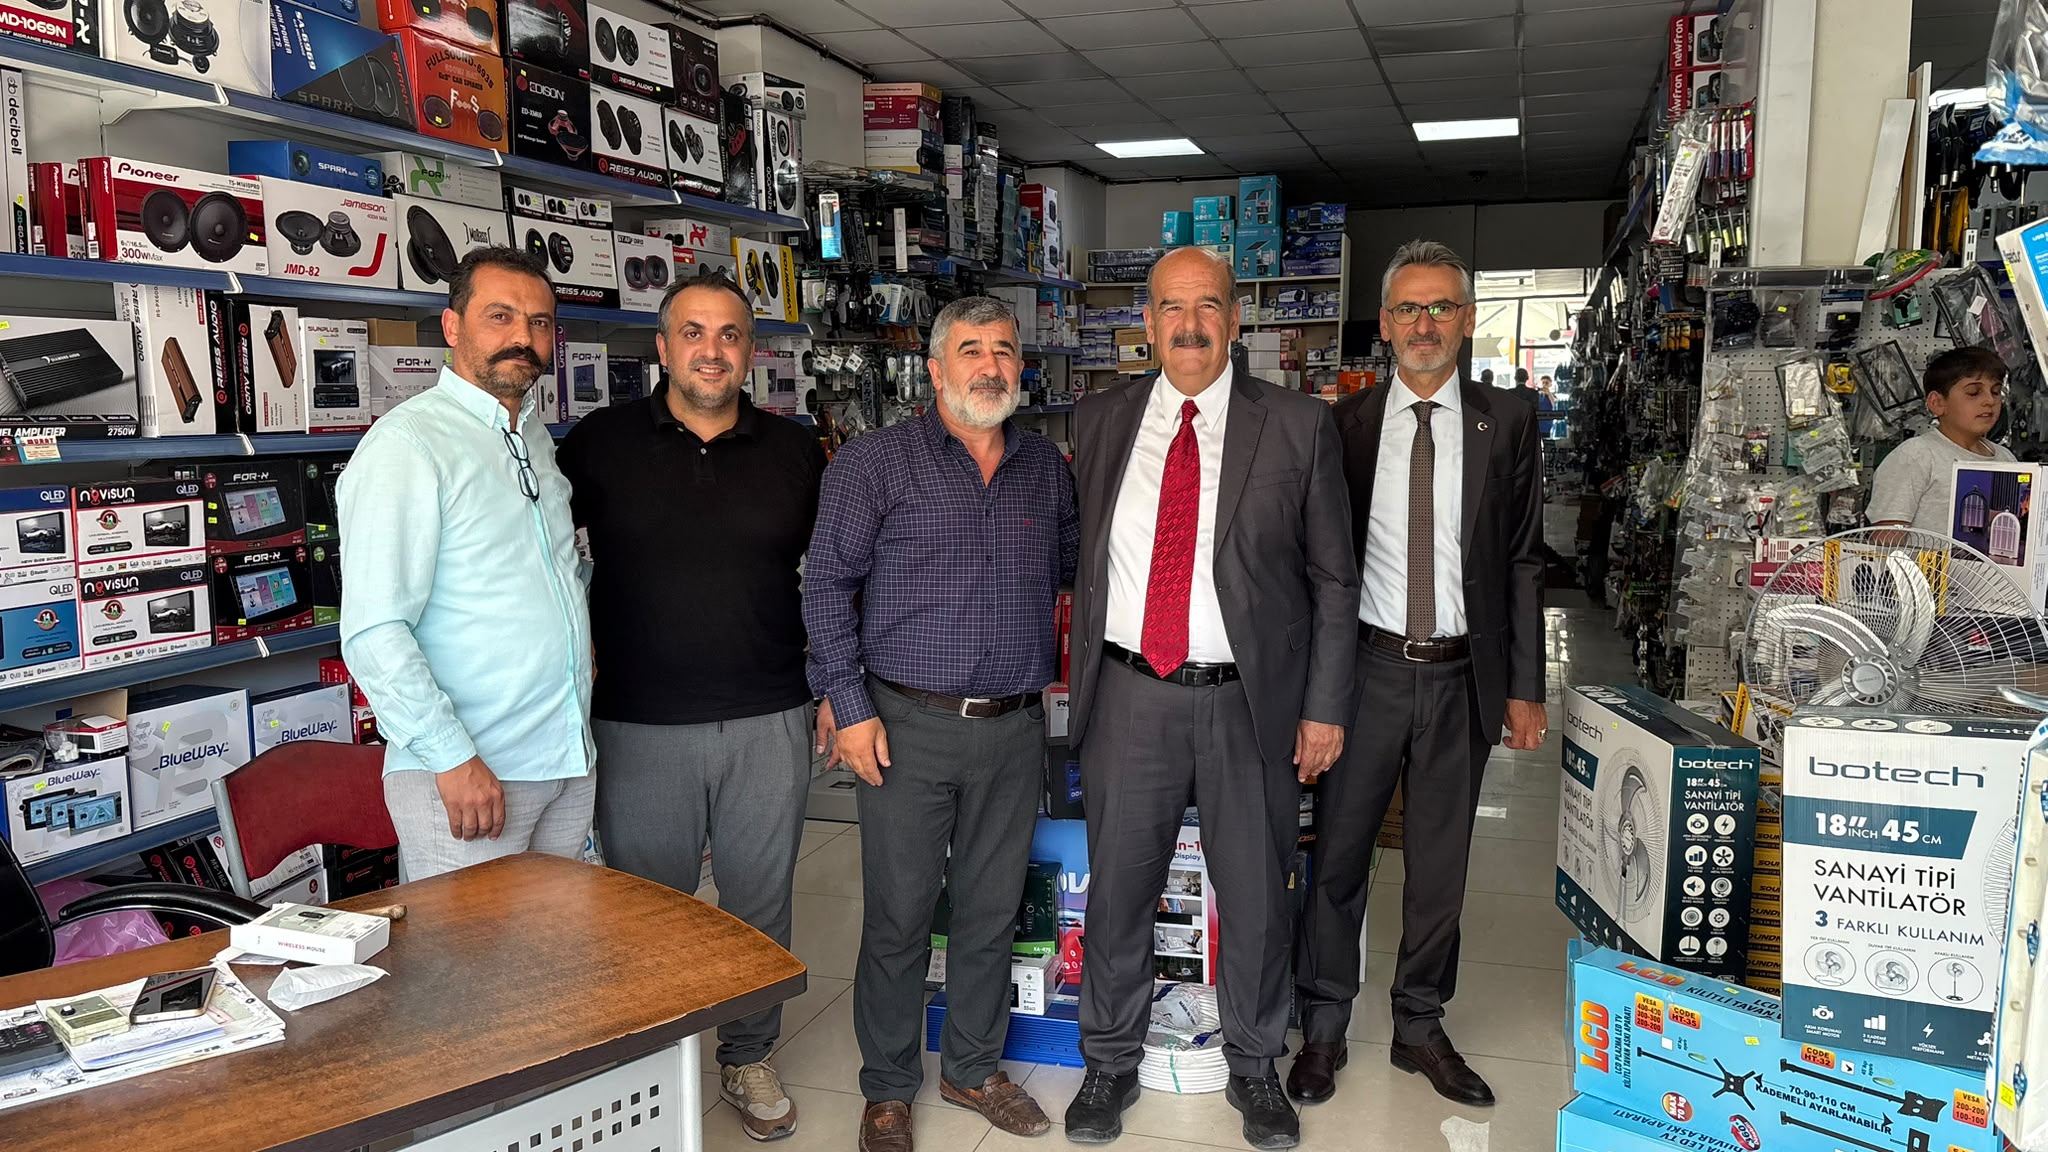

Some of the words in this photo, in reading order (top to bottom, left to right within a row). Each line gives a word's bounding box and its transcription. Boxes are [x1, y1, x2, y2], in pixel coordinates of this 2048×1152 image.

[280, 22, 292, 55] POWER
[294, 10, 317, 71] SA-6969
[1672, 18, 1684, 67] newfron
[529, 81, 565, 102] EDISON
[618, 76, 636, 87] REISS
[636, 80, 654, 92] AUDIO
[297, 90, 354, 114] SPARK
[8, 97, 22, 156] decibell
[117, 162, 180, 182] Pioneer
[318, 161, 348, 174] SPARK
[608, 163, 636, 177] REISS
[636, 169, 663, 182] AUDIO
[52, 165, 60, 199] Pioneer
[701, 183, 721, 193] AUDIO
[766, 166, 774, 211] KENWOOD
[283, 263, 320, 277] JMD-82
[554, 286, 579, 296] REISS
[579, 289, 604, 299] AUDIO
[782, 250, 793, 318] SOUNDMAX
[131, 289, 141, 326] REISS
[209, 300, 219, 345] AUDIO
[135, 326, 145, 362] AUDIO
[240, 336, 249, 373] REISS
[214, 346, 226, 389] REISS
[244, 374, 252, 415] AUDIO
[15, 427, 66, 437] AMPLIFIER
[107, 427, 137, 437] 2750W
[40, 490, 66, 502] QLED
[176, 483, 199, 495] QLED
[180, 569, 204, 581] QLED
[49, 583, 74, 595] QLED
[1617, 703, 1650, 722] botech
[281, 720, 336, 743] BlueWay
[1567, 708, 1604, 743] botech
[159, 742, 226, 769] BlueWay
[1678, 757, 1753, 770] botech
[47, 768, 97, 787] BlueWay
[1809, 756, 1985, 789] botech
[1707, 777, 1721, 788] 45
[1684, 788, 1724, 800] SANAYİ
[1724, 790, 1742, 801] TİPİ
[1684, 800, 1744, 813] VANTİLATÖR
[1847, 828, 1878, 840] INCH
[1881, 819, 1920, 844] 45
[1922, 834, 1942, 846] CM
[1173, 852, 1201, 862] Display
[1814, 858, 1906, 885] SANAYİ
[1915, 866, 1956, 890] TİPİ
[1813, 883, 1967, 917] VANTİLATÖR
[1814, 910, 1829, 928] 3
[1837, 918, 1889, 936] FARKLI
[1898, 925, 1985, 947] KULLANIM
[277, 940, 305, 951] WIRELESS
[306, 945, 326, 954] MOUSE
[1616, 960, 1686, 987] LCD
[1642, 996, 1657, 1007] VESA
[1686, 985, 1729, 1007] KİLİTLİ
[1731, 998, 1775, 1020] TAVAN
[1753, 998, 1780, 1009] LCD
[1616, 1014, 1624, 1024] TV
[1624, 1005, 1632, 1032] APARATI
[1637, 1010, 1661, 1024] 300-300
[1672, 1013, 1697, 1028] HT-35
[1673, 1007, 1696, 1019] CODE
[1615, 1025, 1623, 1037] LED
[1636, 1018, 1661, 1032] 200-200
[1580, 1000, 1610, 1074] LCD
[1614, 1037, 1623, 1063] PLAZMA
[1623, 1049, 1631, 1069] TAVAN
[1806, 1047, 1830, 1059] CODE
[1911, 1046, 1945, 1056] PERFORMANS
[1614, 1063, 1623, 1075] LCD
[1804, 1053, 1832, 1067] HT-32
[1623, 1069, 1631, 1089] KİLİTLİ
[1668, 1095, 1678, 1117] MAX
[1789, 1084, 1838, 1108] 70-90-110
[1839, 1101, 1856, 1114] CM
[1962, 1092, 1981, 1104] VESA
[1677, 1109, 1686, 1121] 70
[1755, 1083, 1807, 1109] KADEMELİ
[1808, 1101, 1892, 1136] AYARLANABİLİR
[1955, 1101, 1986, 1116] 200-200
[1612, 1109, 1667, 1129] APARATI
[1955, 1111, 1985, 1126] 100-100
[1659, 1132, 1679, 1145] TV
[1666, 1124, 1697, 1139] ASKI
[1679, 1136, 1706, 1149] LED
